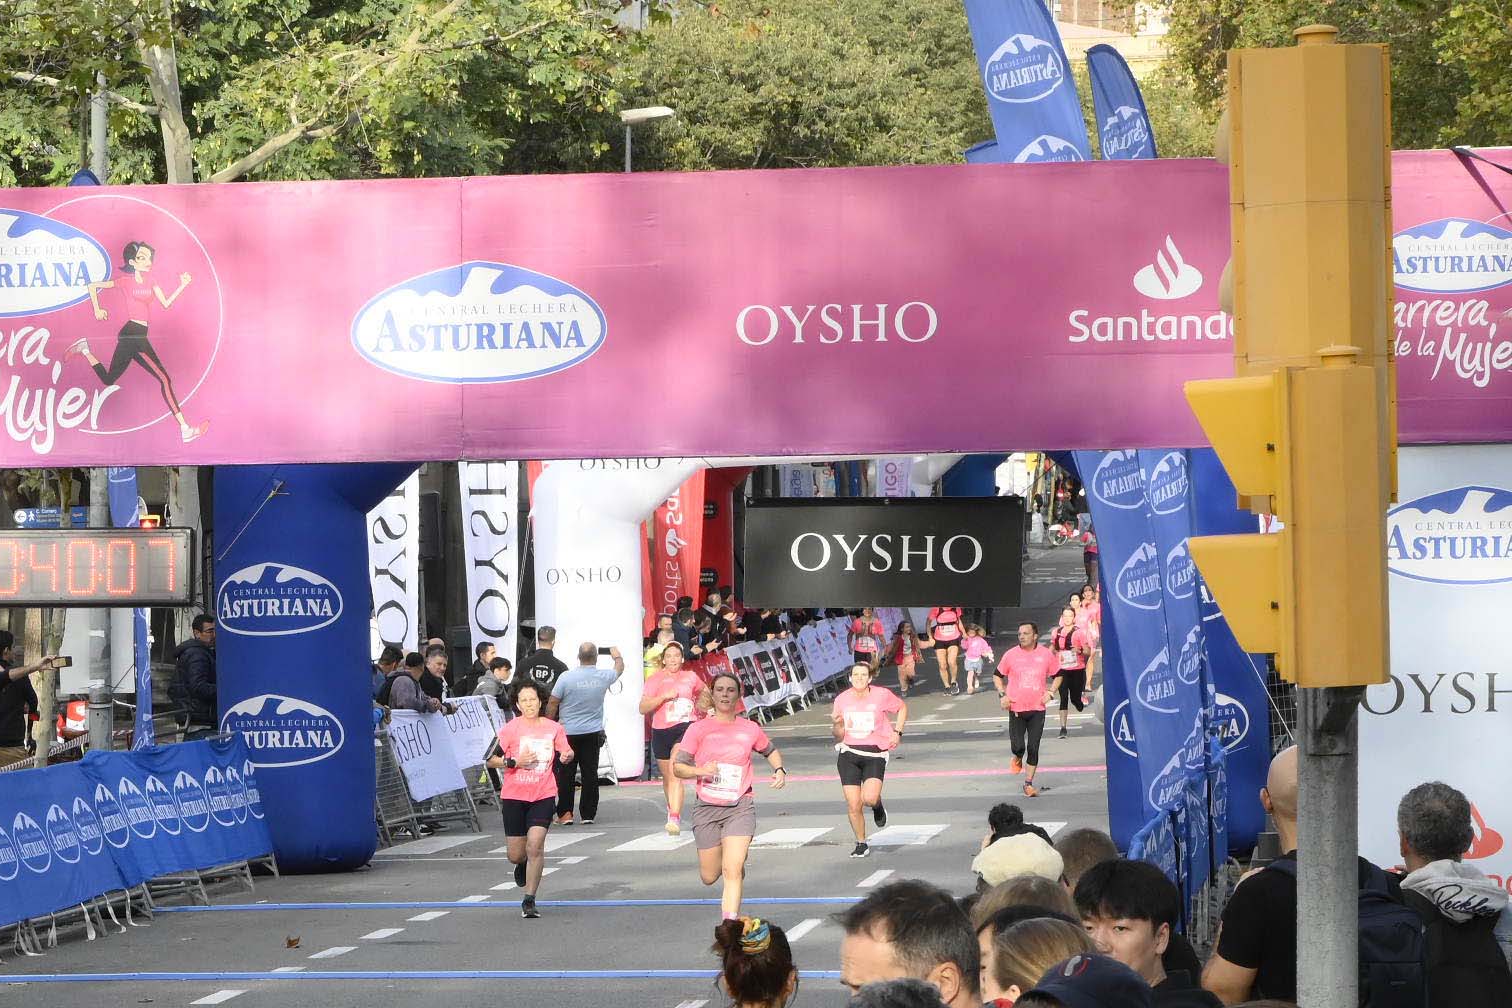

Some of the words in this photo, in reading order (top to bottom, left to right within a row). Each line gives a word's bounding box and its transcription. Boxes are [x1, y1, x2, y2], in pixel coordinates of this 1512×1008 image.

[497, 301, 579, 315] LECHERA
[1393, 299, 1490, 328] arrera
[372, 309, 587, 354] ASTURIANA
[735, 301, 938, 346] OYSHO
[1068, 308, 1234, 343] Santand
[1417, 330, 1436, 356] la
[1430, 327, 1512, 388] Muje
[1414, 521, 1482, 531] CENTRAL
[790, 532, 983, 573] OYSHO
[545, 566, 622, 586] OYSHO
[234, 588, 275, 596] CENTRAL
[280, 587, 329, 596] LECHERA
[221, 592, 334, 620] ASTURIANA
[535, 670, 549, 679] BP
[1360, 671, 1512, 716] OYSH
[236, 719, 277, 728] CENTRAL
[281, 718, 330, 727] LECHERA
